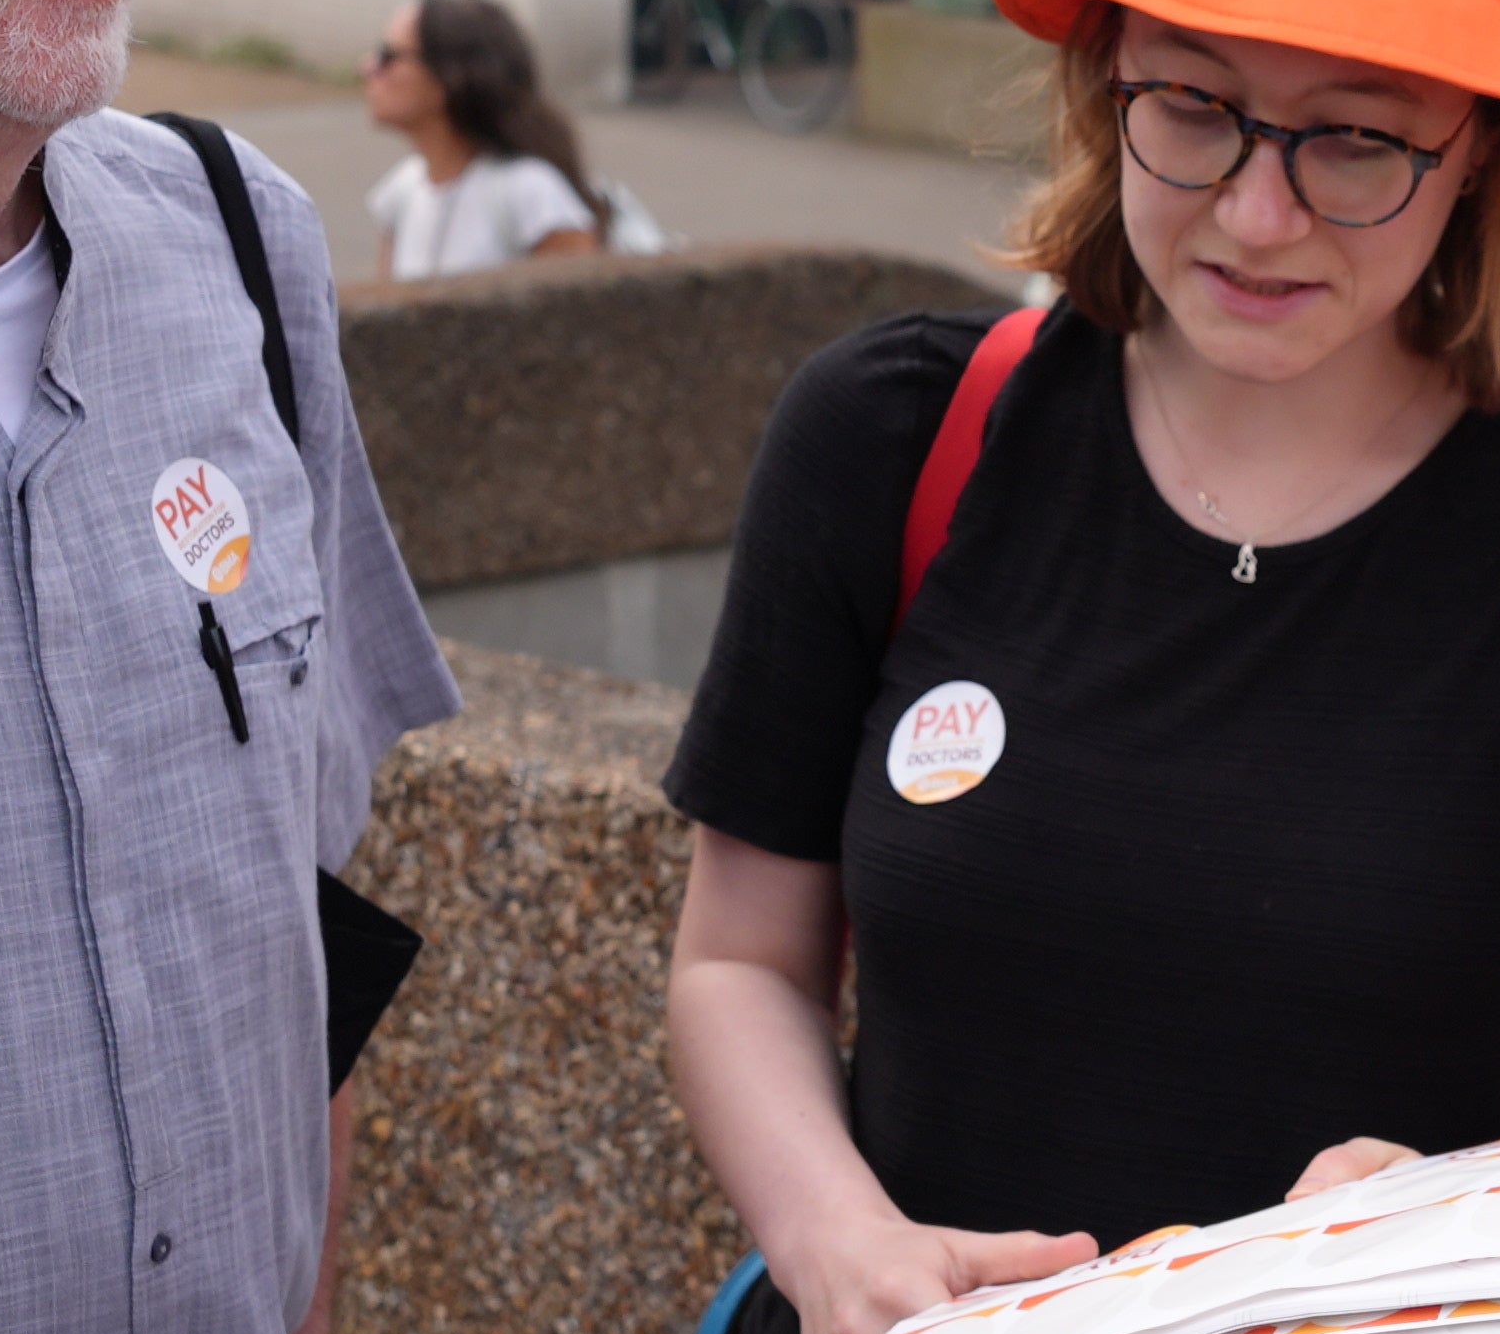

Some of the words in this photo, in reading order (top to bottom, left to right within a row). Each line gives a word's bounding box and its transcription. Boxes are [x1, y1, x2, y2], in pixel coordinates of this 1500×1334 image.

[155, 464, 213, 542] PAY
[183, 511, 235, 567] DOCTORS
[912, 698, 990, 740] PAY
[906, 745, 983, 767] DOCTORS
